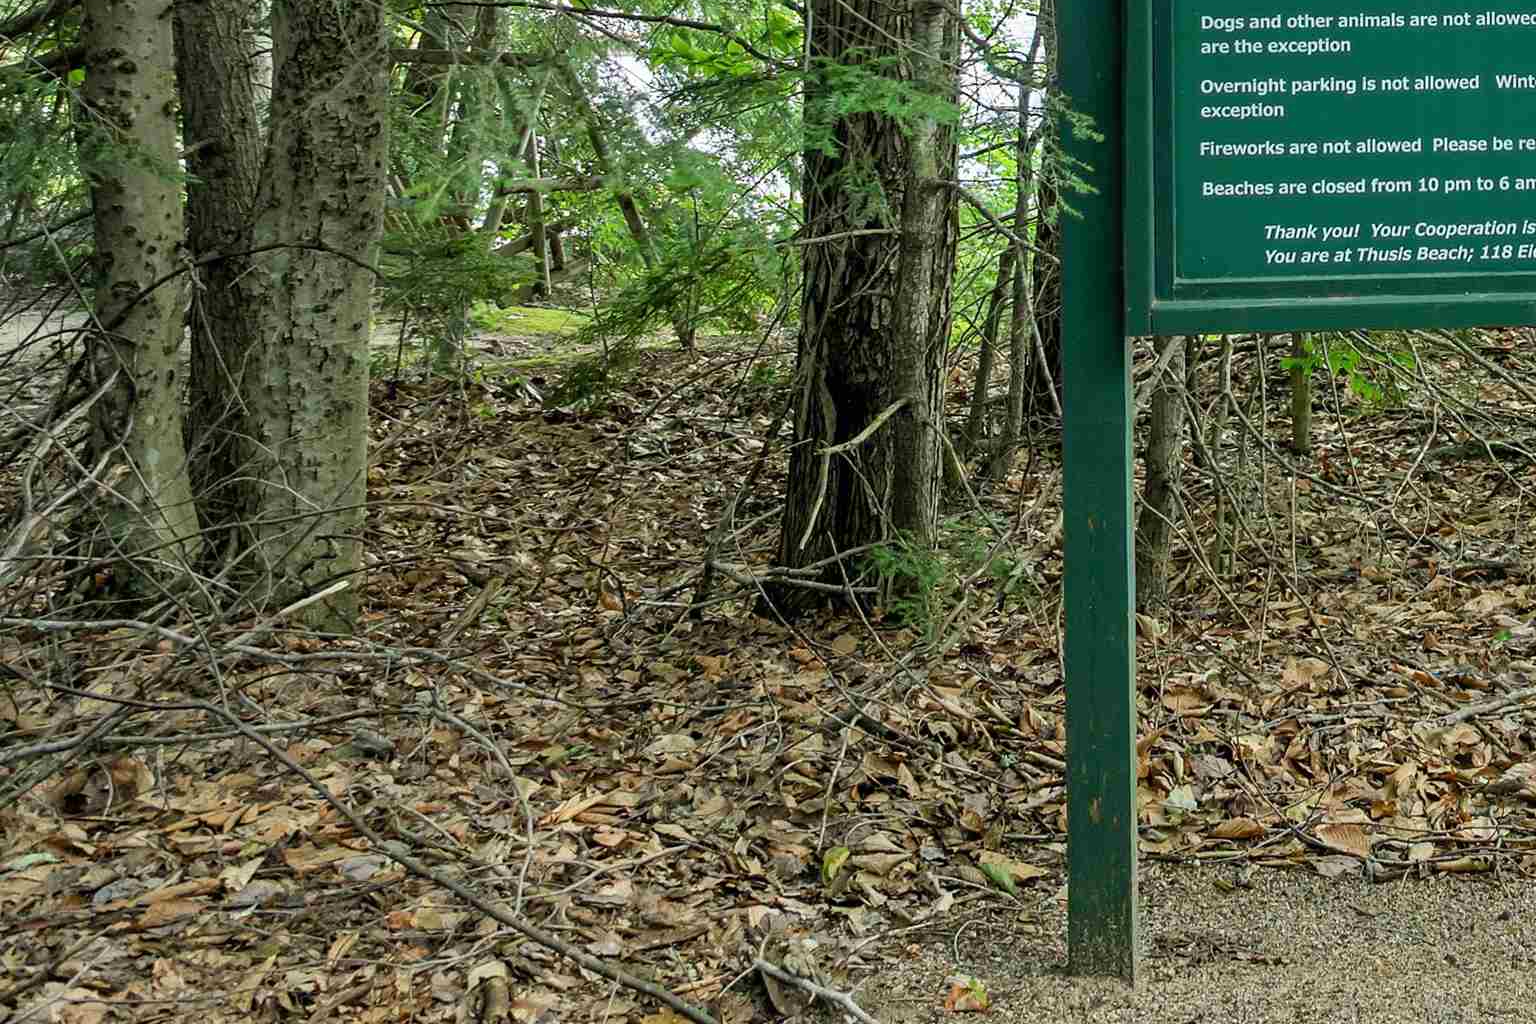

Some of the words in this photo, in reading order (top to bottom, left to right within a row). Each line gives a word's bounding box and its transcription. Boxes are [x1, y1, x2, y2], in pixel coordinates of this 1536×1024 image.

[1200, 41, 1229, 54] are
[1233, 38, 1263, 54] the
[1267, 36, 1351, 55] exception
[1200, 77, 1286, 96] Overnight
[1291, 75, 1356, 96] parking
[1361, 75, 1376, 91] is
[1380, 75, 1410, 91] not
[1413, 74, 1479, 90] allowed
[1200, 101, 1284, 120] exception
[1202, 179, 1274, 196] Beaches
[1277, 181, 1307, 195] are
[1311, 177, 1365, 194] closed
[1370, 177, 1412, 193] from
[1417, 176, 1439, 192] 10
[1444, 178, 1471, 194] pm
[1475, 176, 1494, 191] to
[1498, 175, 1510, 191] 6
[1263, 222, 1318, 239] Thank
[1321, 222, 1360, 242] you!
[1370, 222, 1411, 238] Your
[1413, 219, 1517, 239] Cooperation
[1521, 219, 1536, 234] is
[1264, 248, 1297, 264] You
[1299, 250, 1330, 263] are
[1332, 247, 1353, 263] at
[1356, 245, 1412, 262] Thusis
[1415, 244, 1474, 263] Beach;
[1479, 244, 1513, 260] 118
